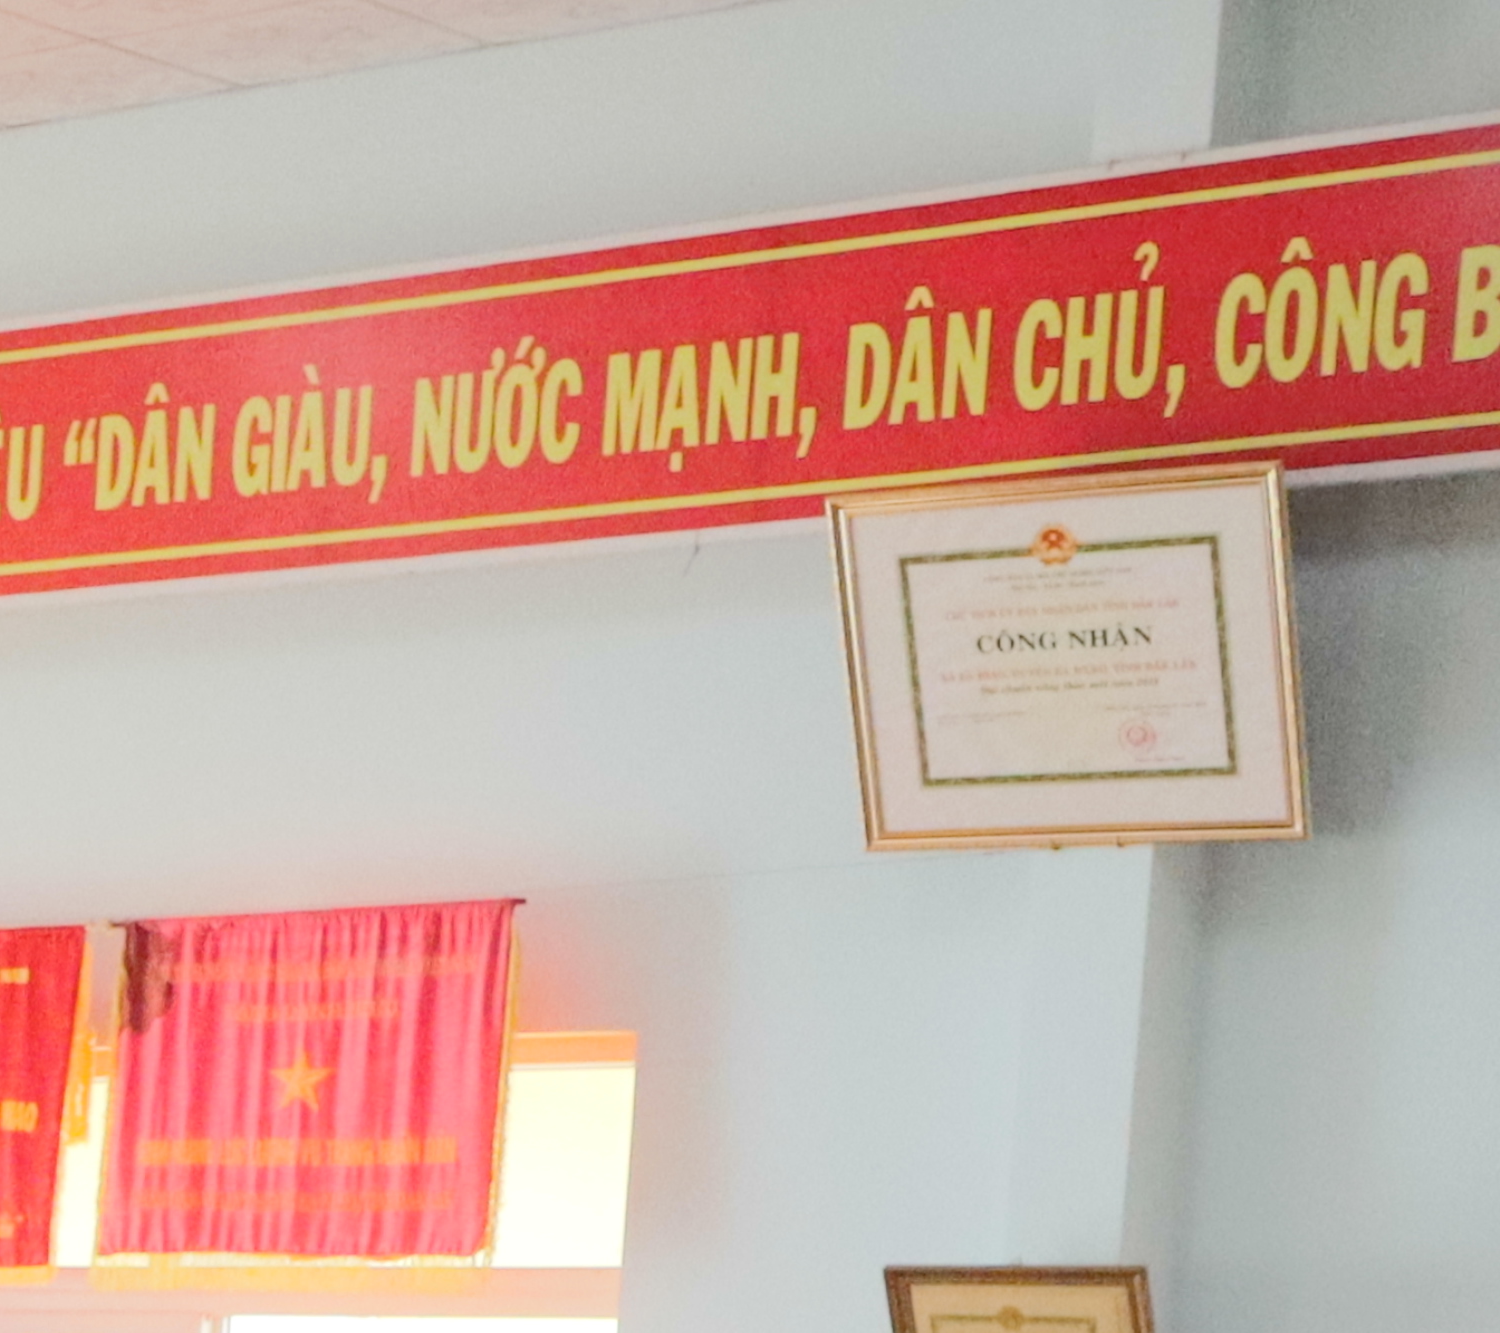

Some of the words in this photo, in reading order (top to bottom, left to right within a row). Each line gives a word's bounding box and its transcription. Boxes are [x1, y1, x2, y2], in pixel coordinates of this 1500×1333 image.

[231, 364, 389, 503] GIÀU,
[409, 336, 584, 477] NƯỚC
[601, 332, 817, 472] MẠNH,
[842, 286, 993, 430] DÂN
[1013, 242, 1186, 418] CHỦ,
[1214, 236, 1430, 388] CÔNG
[976, 629, 1057, 654] CÔNG
[1069, 622, 1153, 651] NHẬN
